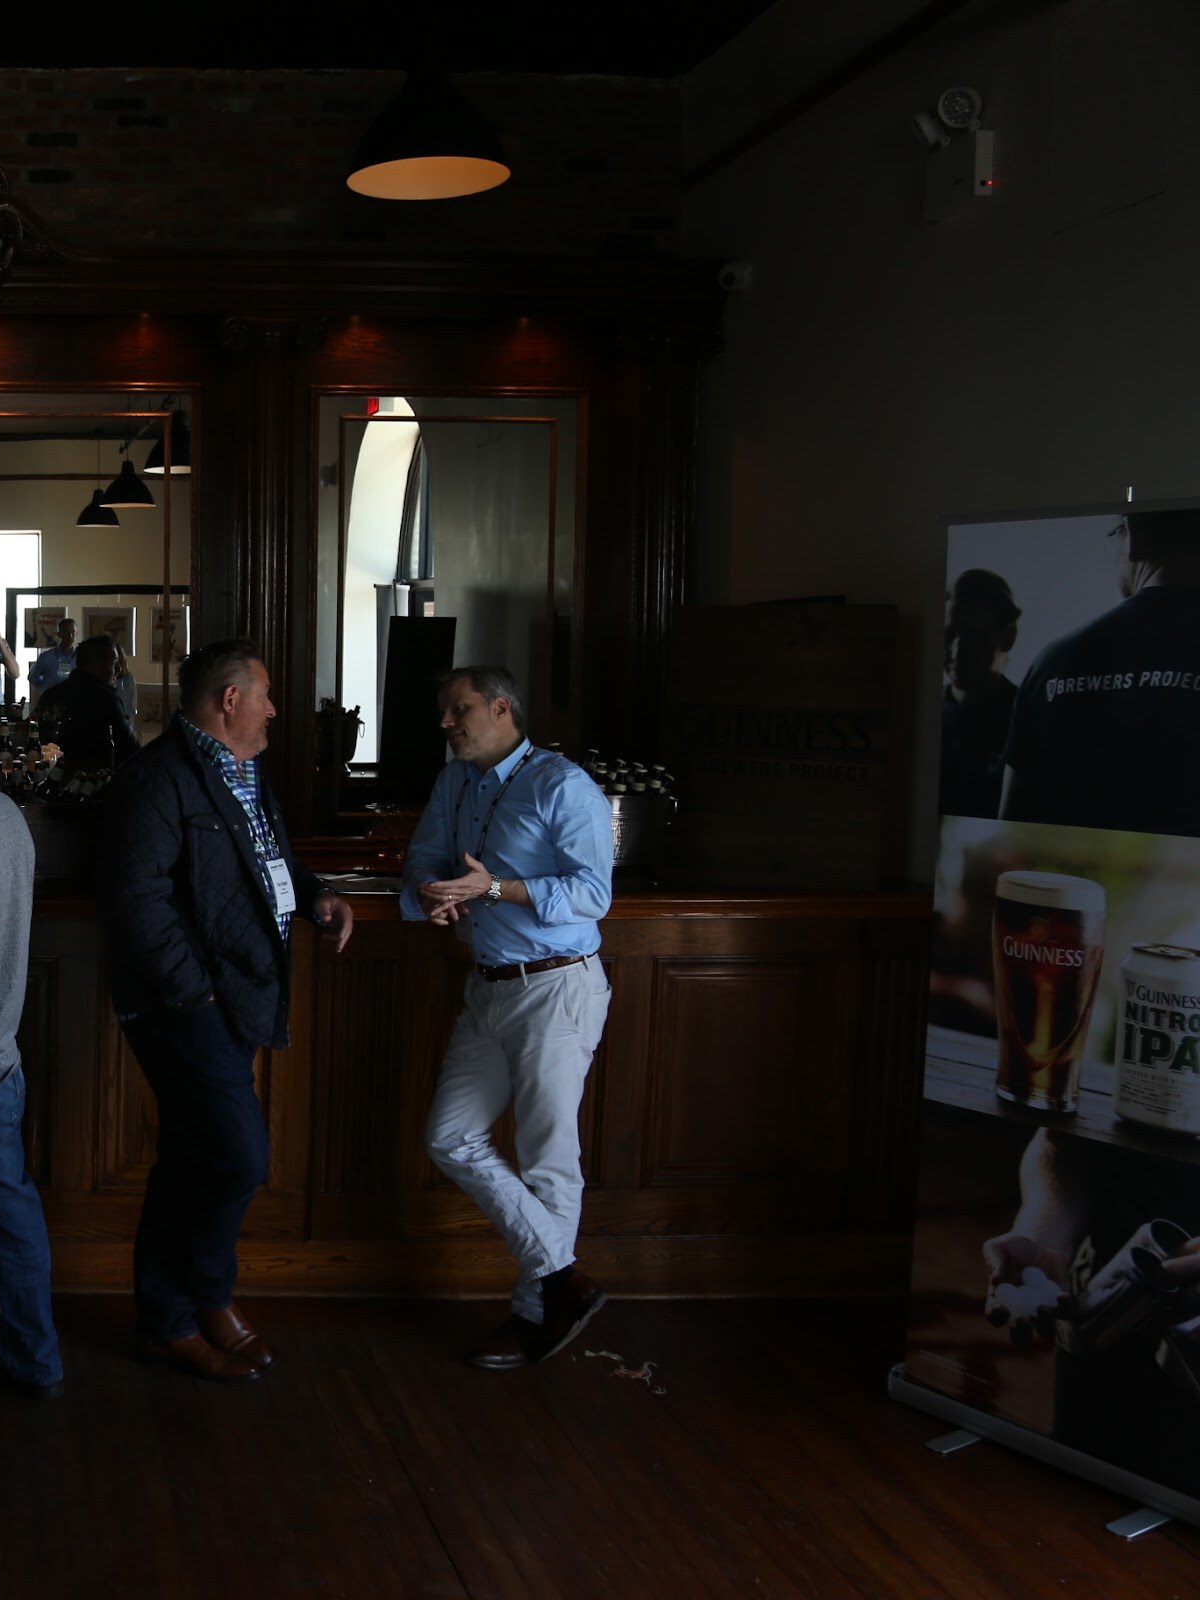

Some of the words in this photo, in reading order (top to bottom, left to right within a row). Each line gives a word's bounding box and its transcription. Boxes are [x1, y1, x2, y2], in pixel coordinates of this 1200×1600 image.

[1057, 673, 1134, 695] BREWERS
[677, 709, 871, 753] GUINNESS
[1002, 935, 1085, 968] GUINNESS
[1124, 1000, 1200, 1033] NITRO
[1122, 1022, 1200, 1074] IPA
